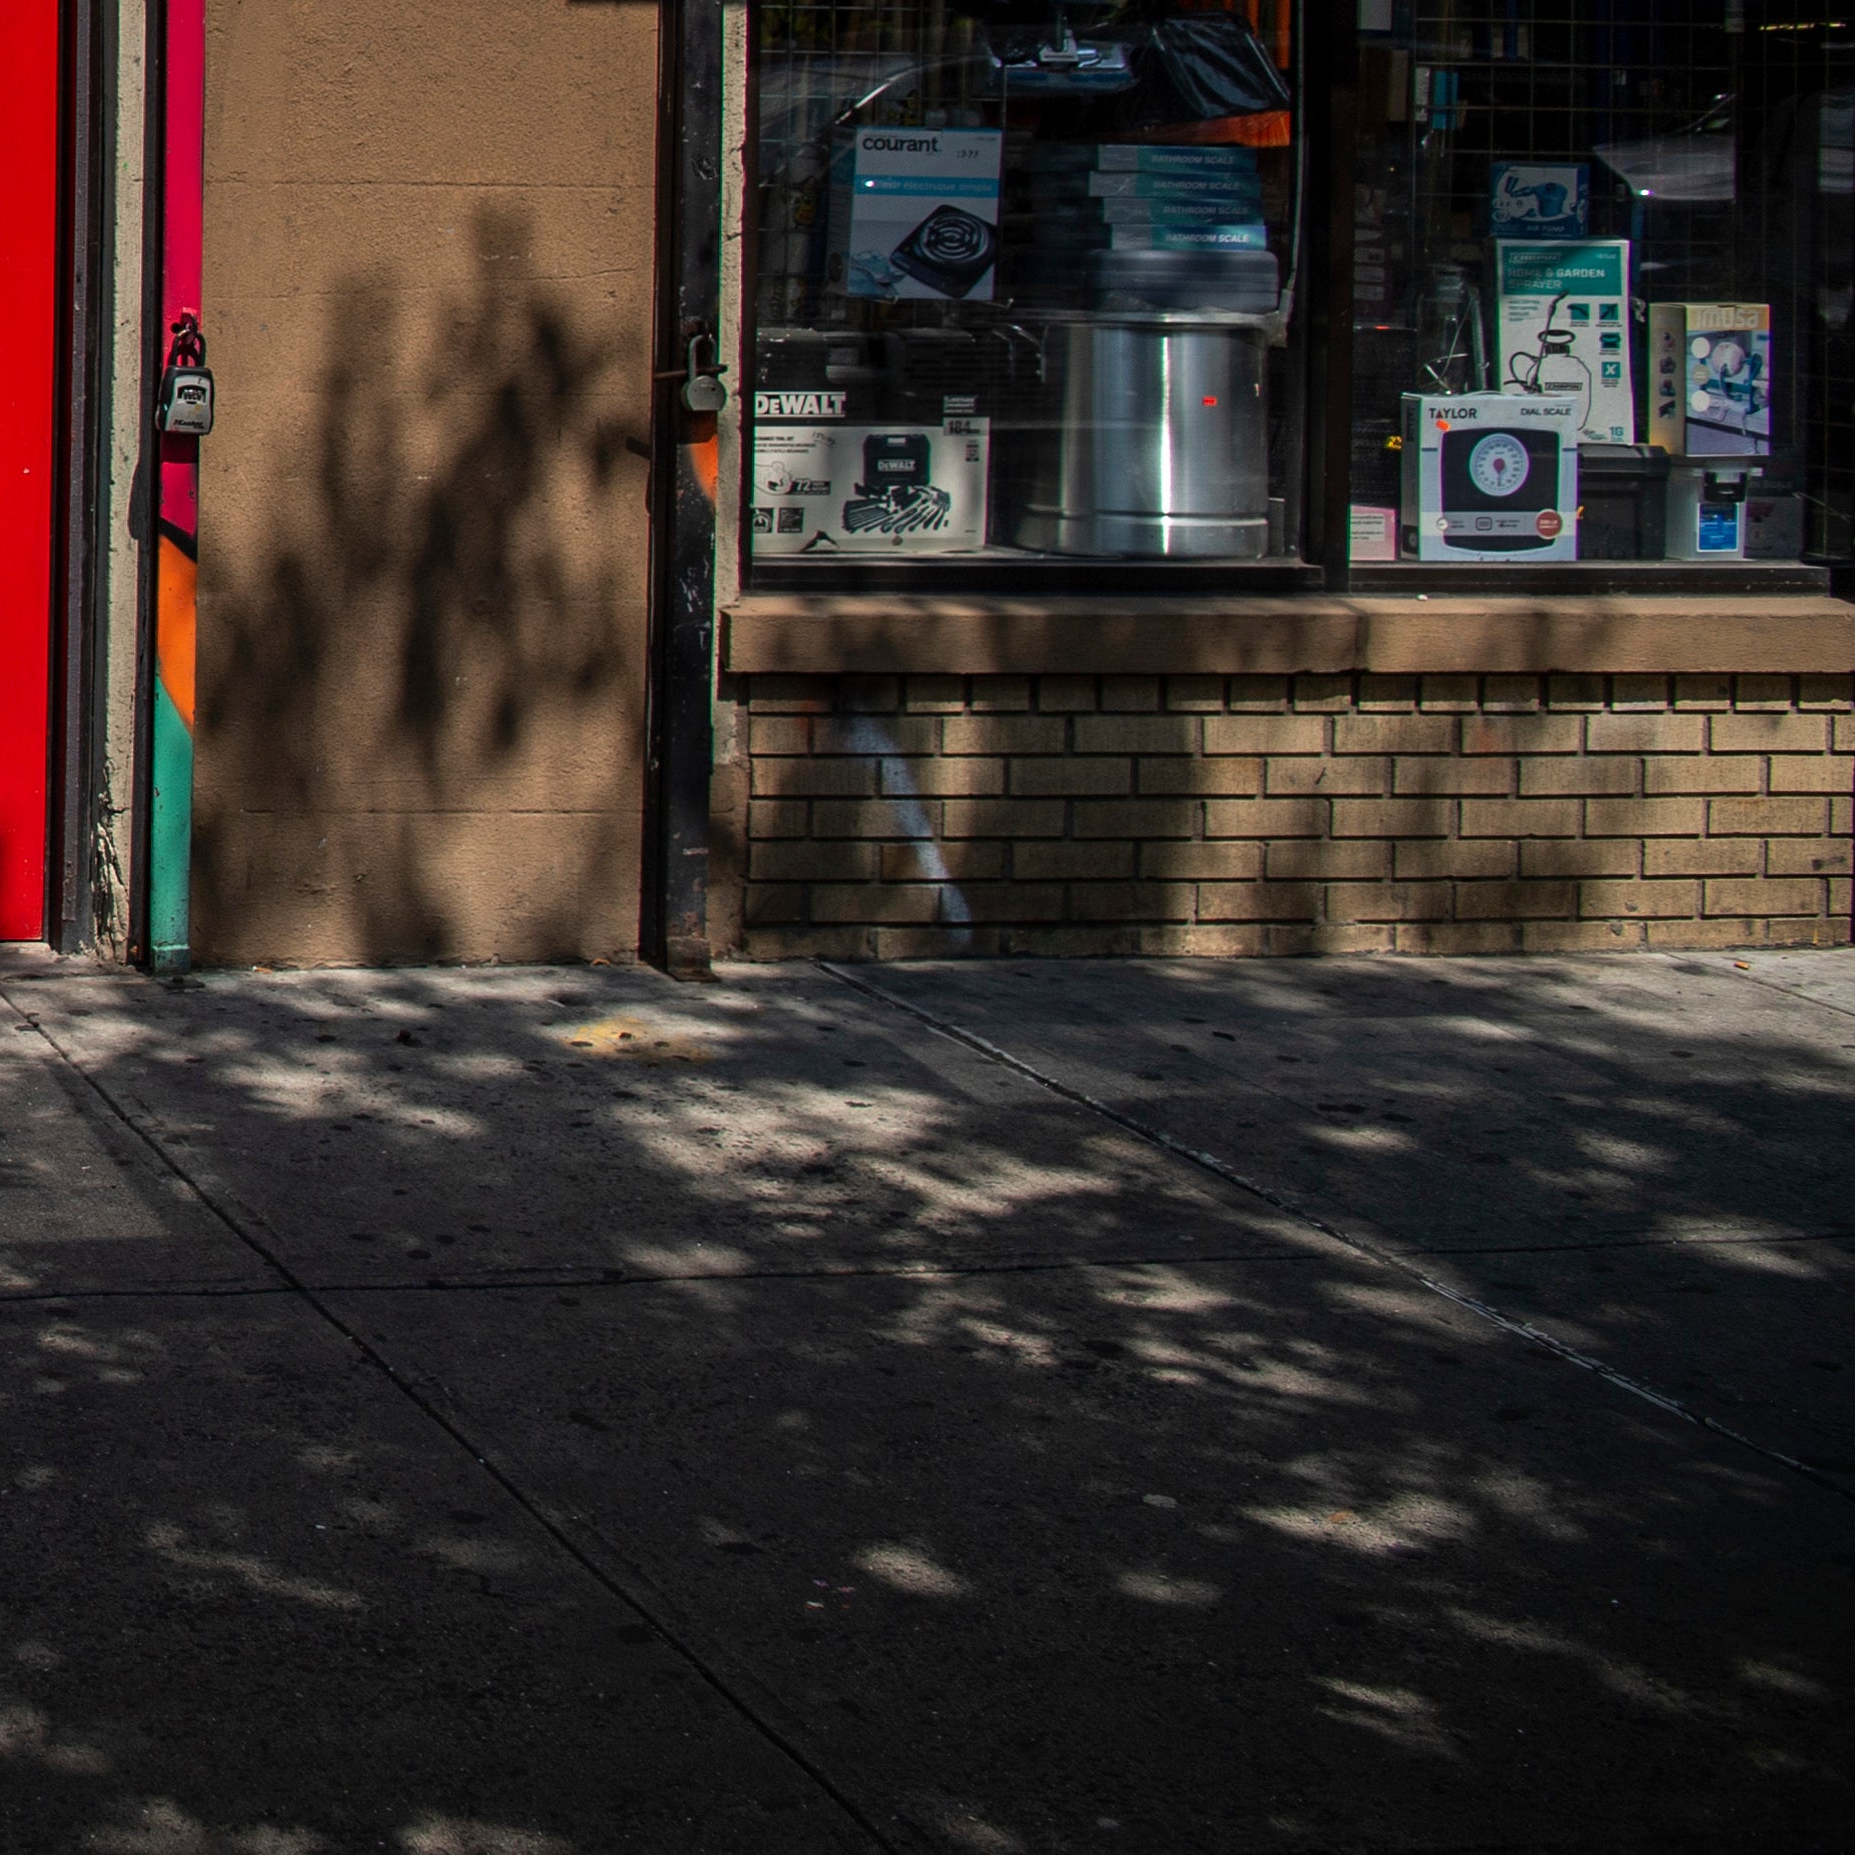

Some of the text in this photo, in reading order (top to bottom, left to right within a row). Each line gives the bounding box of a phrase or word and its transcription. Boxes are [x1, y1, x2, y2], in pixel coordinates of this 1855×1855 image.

[863, 137, 938, 152] courant
[1218, 234, 1250, 243] SCALE
[1556, 269, 1606, 279] GARDEN
[1507, 279, 1563, 289] SPRAYER
[1429, 408, 1572, 419] TAYLOR DIAL SCALE
